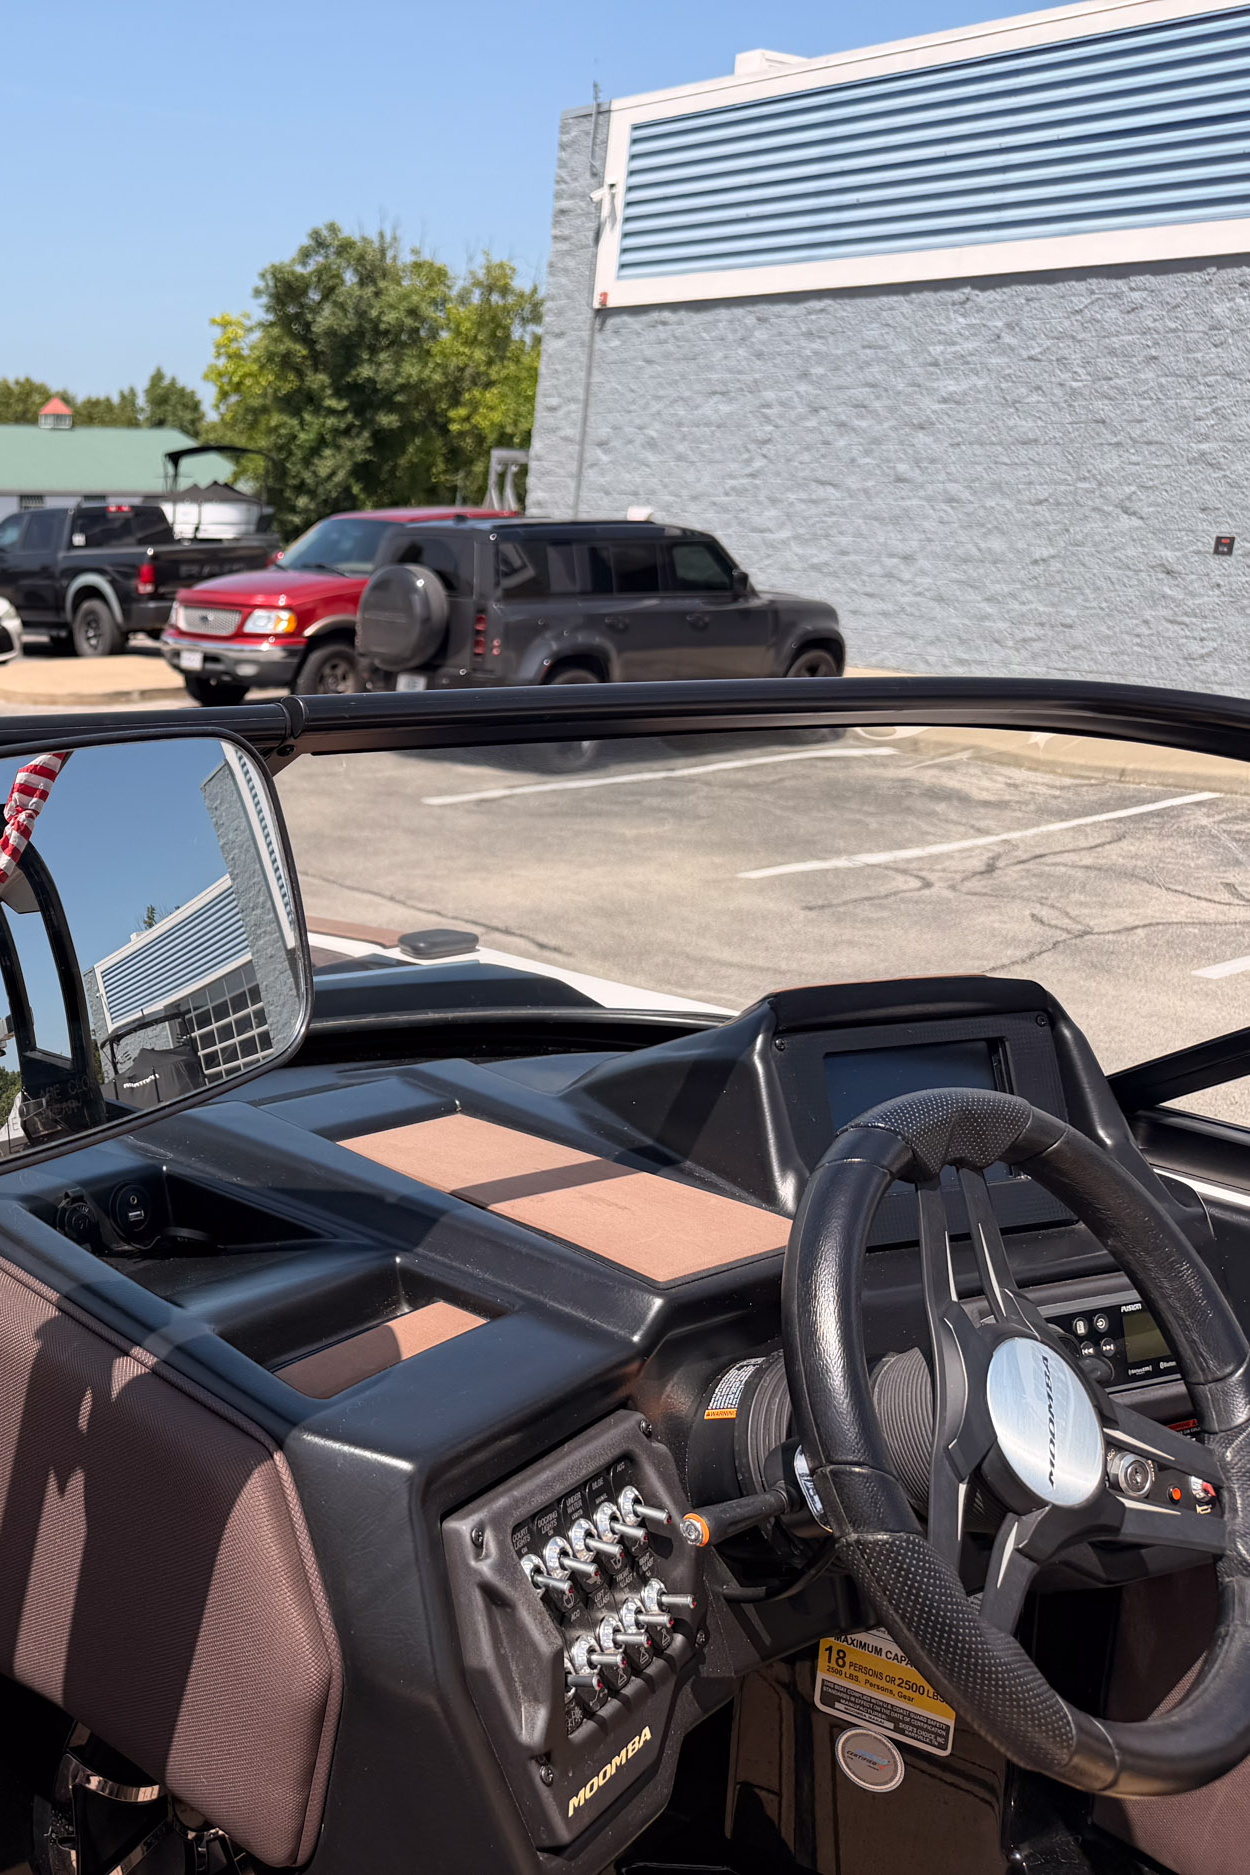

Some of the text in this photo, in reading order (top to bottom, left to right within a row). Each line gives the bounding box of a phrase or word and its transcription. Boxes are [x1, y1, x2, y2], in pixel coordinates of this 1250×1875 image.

[537, 1510, 558, 1528] DOCKING
[541, 1518, 558, 1534] LIGHTS
[514, 1533, 531, 1550] LIGHTS
[834, 1635, 914, 1668] MAXIMUM CAPA
[824, 1645, 847, 1668] 18
[848, 1661, 884, 1681] PERSONS
[885, 1675, 897, 1686] OR
[897, 1677, 925, 1696] 2500
[827, 1665, 915, 1703] 2500 LBS. Persons, Gear
[856, 1697, 873, 1709] EFFECT
[911, 1717, 946, 1736] CERTIFICATION
[892, 1704, 910, 1716] COAST
[910, 1711, 927, 1723] GUARD
[927, 1717, 946, 1730] SAFETY
[568, 1725, 652, 1818] MOOMBA
